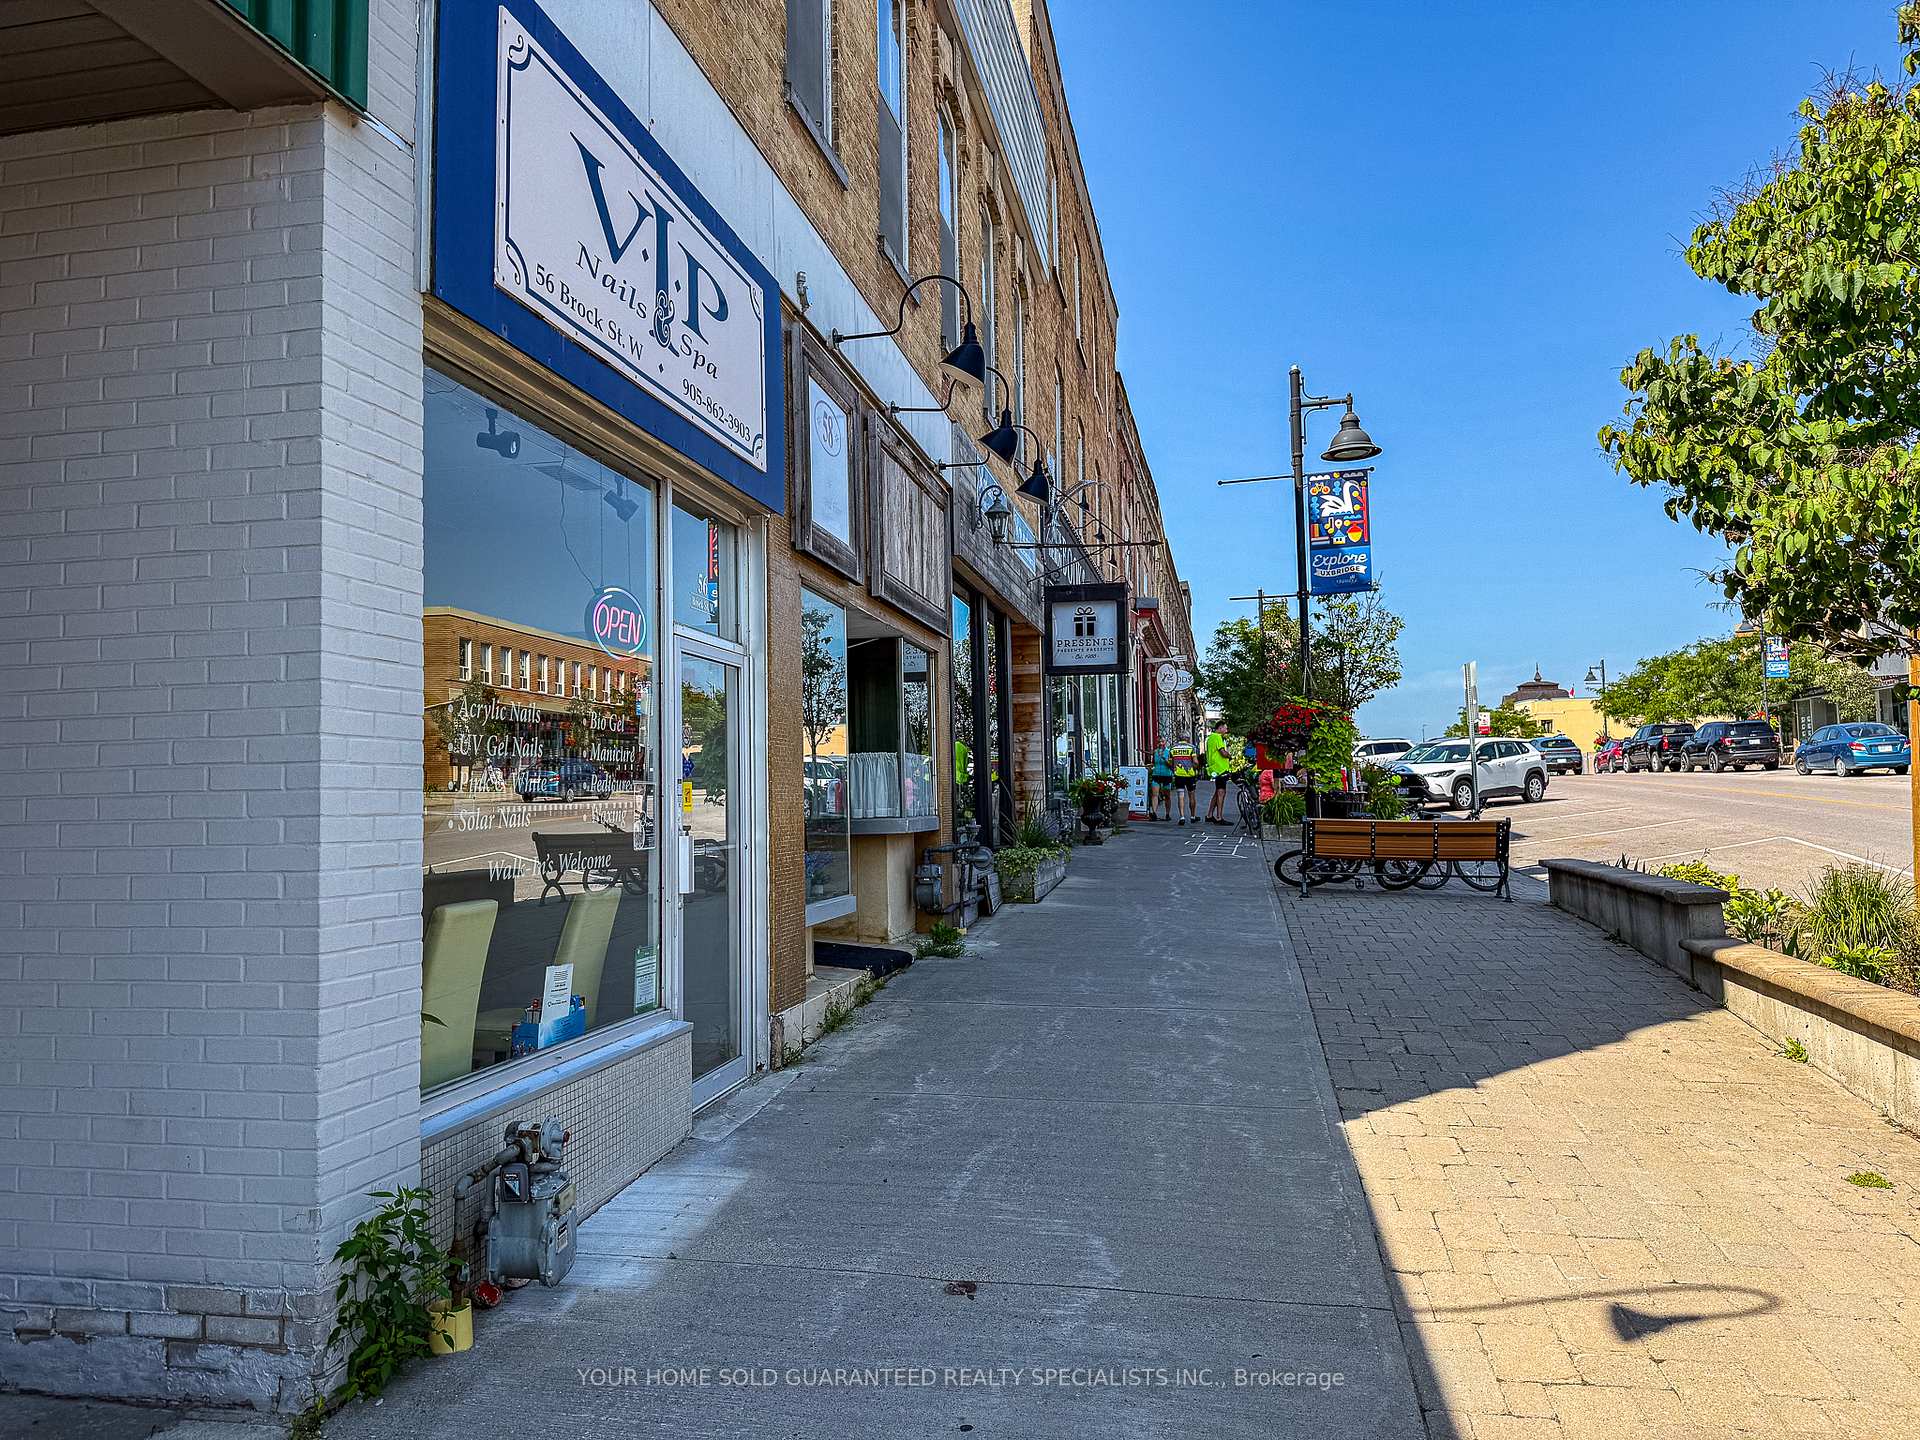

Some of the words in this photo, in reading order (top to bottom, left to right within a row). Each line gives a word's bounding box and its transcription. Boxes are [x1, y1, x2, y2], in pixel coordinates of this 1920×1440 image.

[535, 263, 555, 293] 56
[559, 280, 603, 332] Brock
[628, 335, 644, 361] W
[576, 241, 647, 319] Nails
[680, 333, 718, 379] Spa
[682, 378, 751, 442] 905-862-3903
[1312, 553, 1368, 571] Explore
[1320, 565, 1361, 577] UXBRIDGE
[596, 603, 641, 645] OPEN
[1057, 637, 1114, 648] PRESENTS
[458, 696, 507, 727] Acrylic
[510, 701, 541, 724] Nails
[591, 711, 607, 731] Bio
[609, 714, 625, 733] Gel
[458, 732, 483, 756] UV
[487, 734, 509, 757] Gel
[512, 736, 544, 758] Nails
[590, 742, 635, 763] Manicure
[511, 769, 548, 793] White
[458, 807, 495, 832] Solar
[497, 806, 531, 829] Nails
[592, 805, 628, 828] Waxing
[559, 851, 612, 874] Welcome
